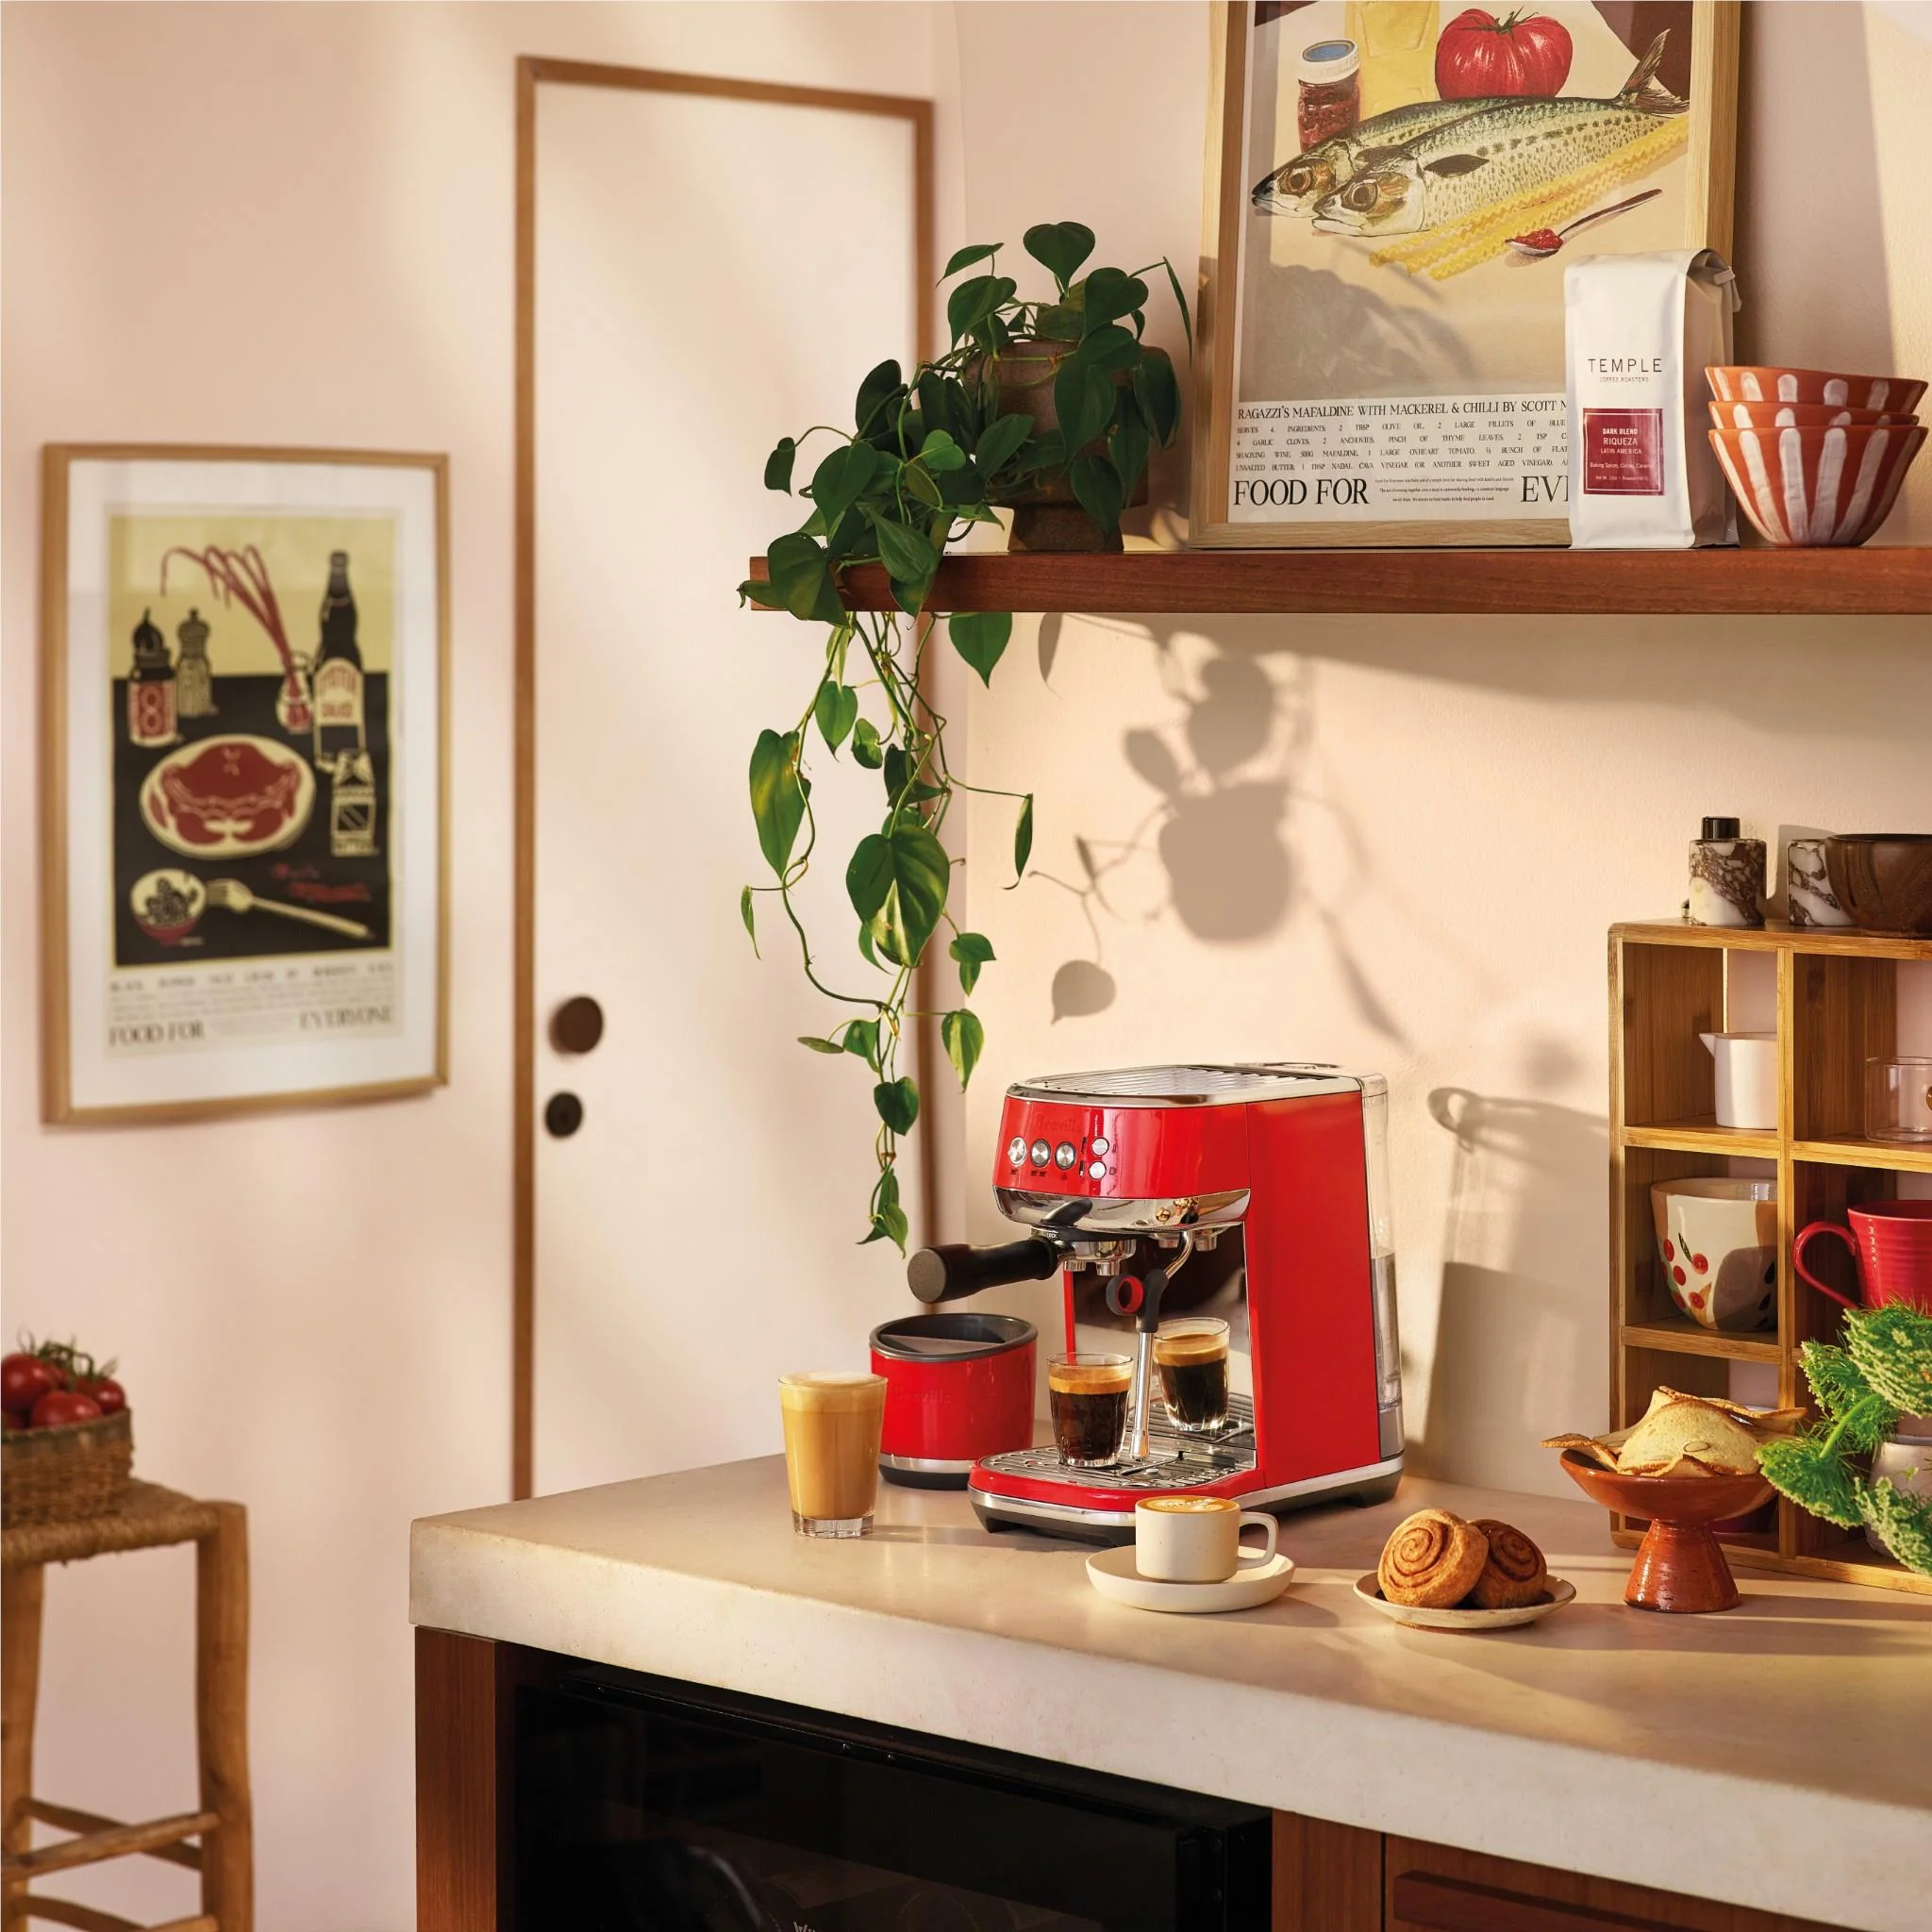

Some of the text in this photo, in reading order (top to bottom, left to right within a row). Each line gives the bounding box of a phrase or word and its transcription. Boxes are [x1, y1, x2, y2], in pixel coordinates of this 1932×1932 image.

[1588, 358, 1662, 373] TEMPLE
[1293, 406, 1354, 418] MAFALDINE
[1358, 406, 1386, 415] WITH
[1390, 404, 1448, 415] MACKEREL
[1452, 403, 1459, 413] &
[1463, 402, 1499, 413] CHILLI
[1503, 402, 1517, 412] BY
[1522, 401, 1557, 411] SCOTT
[1233, 479, 1307, 506] FOOD
[1315, 477, 1370, 505] FOR
[108, 1023, 163, 1046] FOOD
[168, 1020, 205, 1041] FOR
